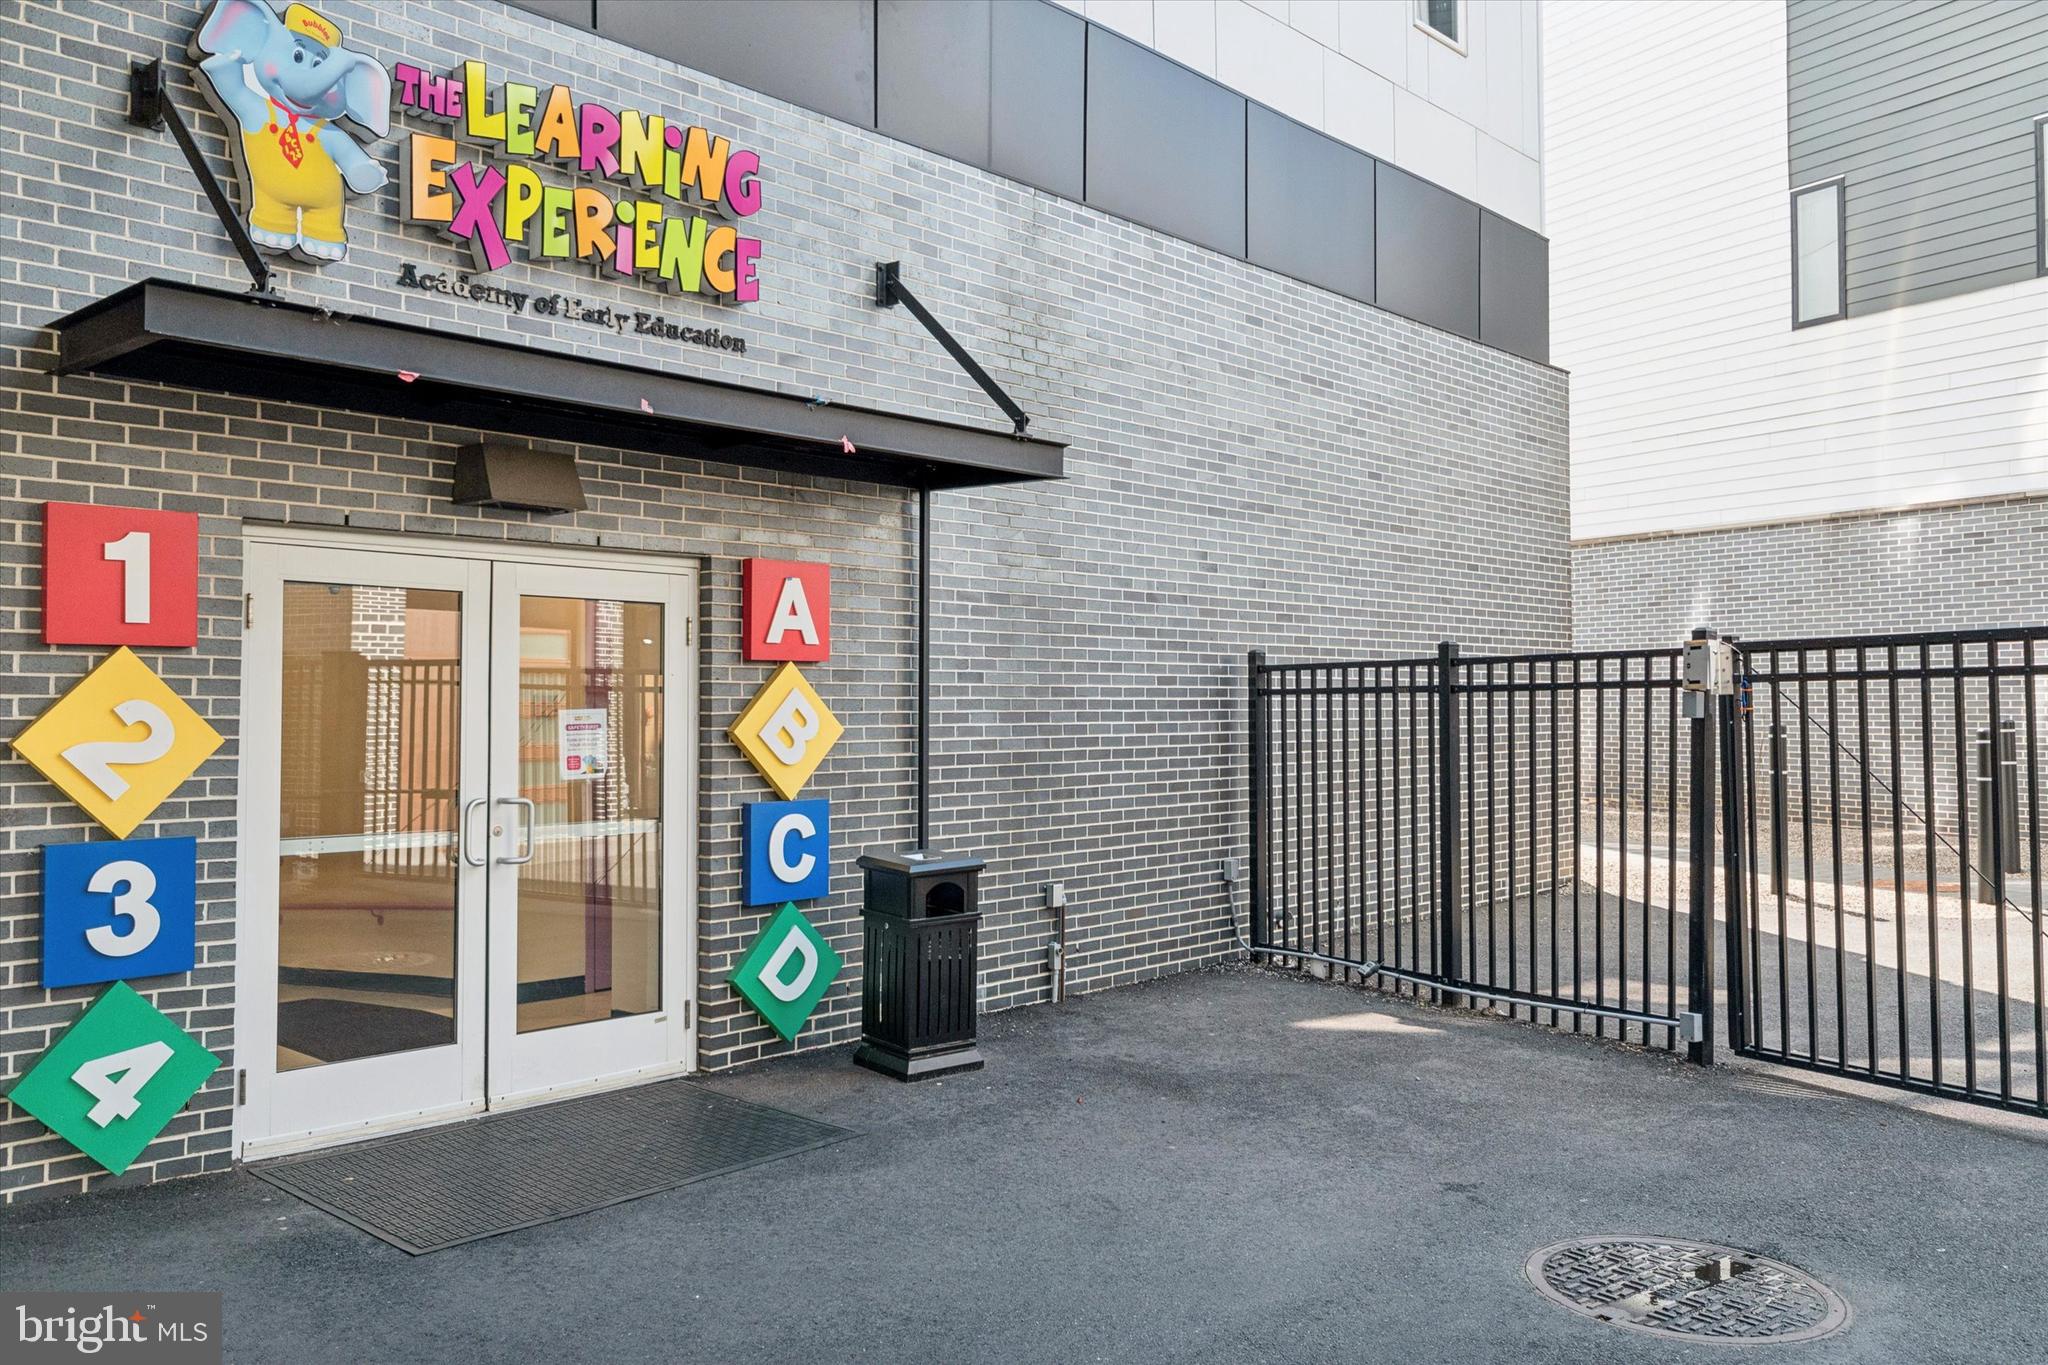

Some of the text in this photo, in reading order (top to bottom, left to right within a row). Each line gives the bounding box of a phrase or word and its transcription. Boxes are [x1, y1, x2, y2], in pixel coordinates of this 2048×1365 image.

[395, 62, 464, 118] THE
[396, 263, 748, 353] Academy of Early Education
[104, 531, 151, 624] 1
[765, 577, 820, 645] A
[59, 699, 176, 802] 2
[757, 687, 820, 766] B
[768, 813, 817, 883] C
[85, 860, 161, 957] 3
[757, 924, 819, 1002] D
[70, 1040, 175, 1129] 4
